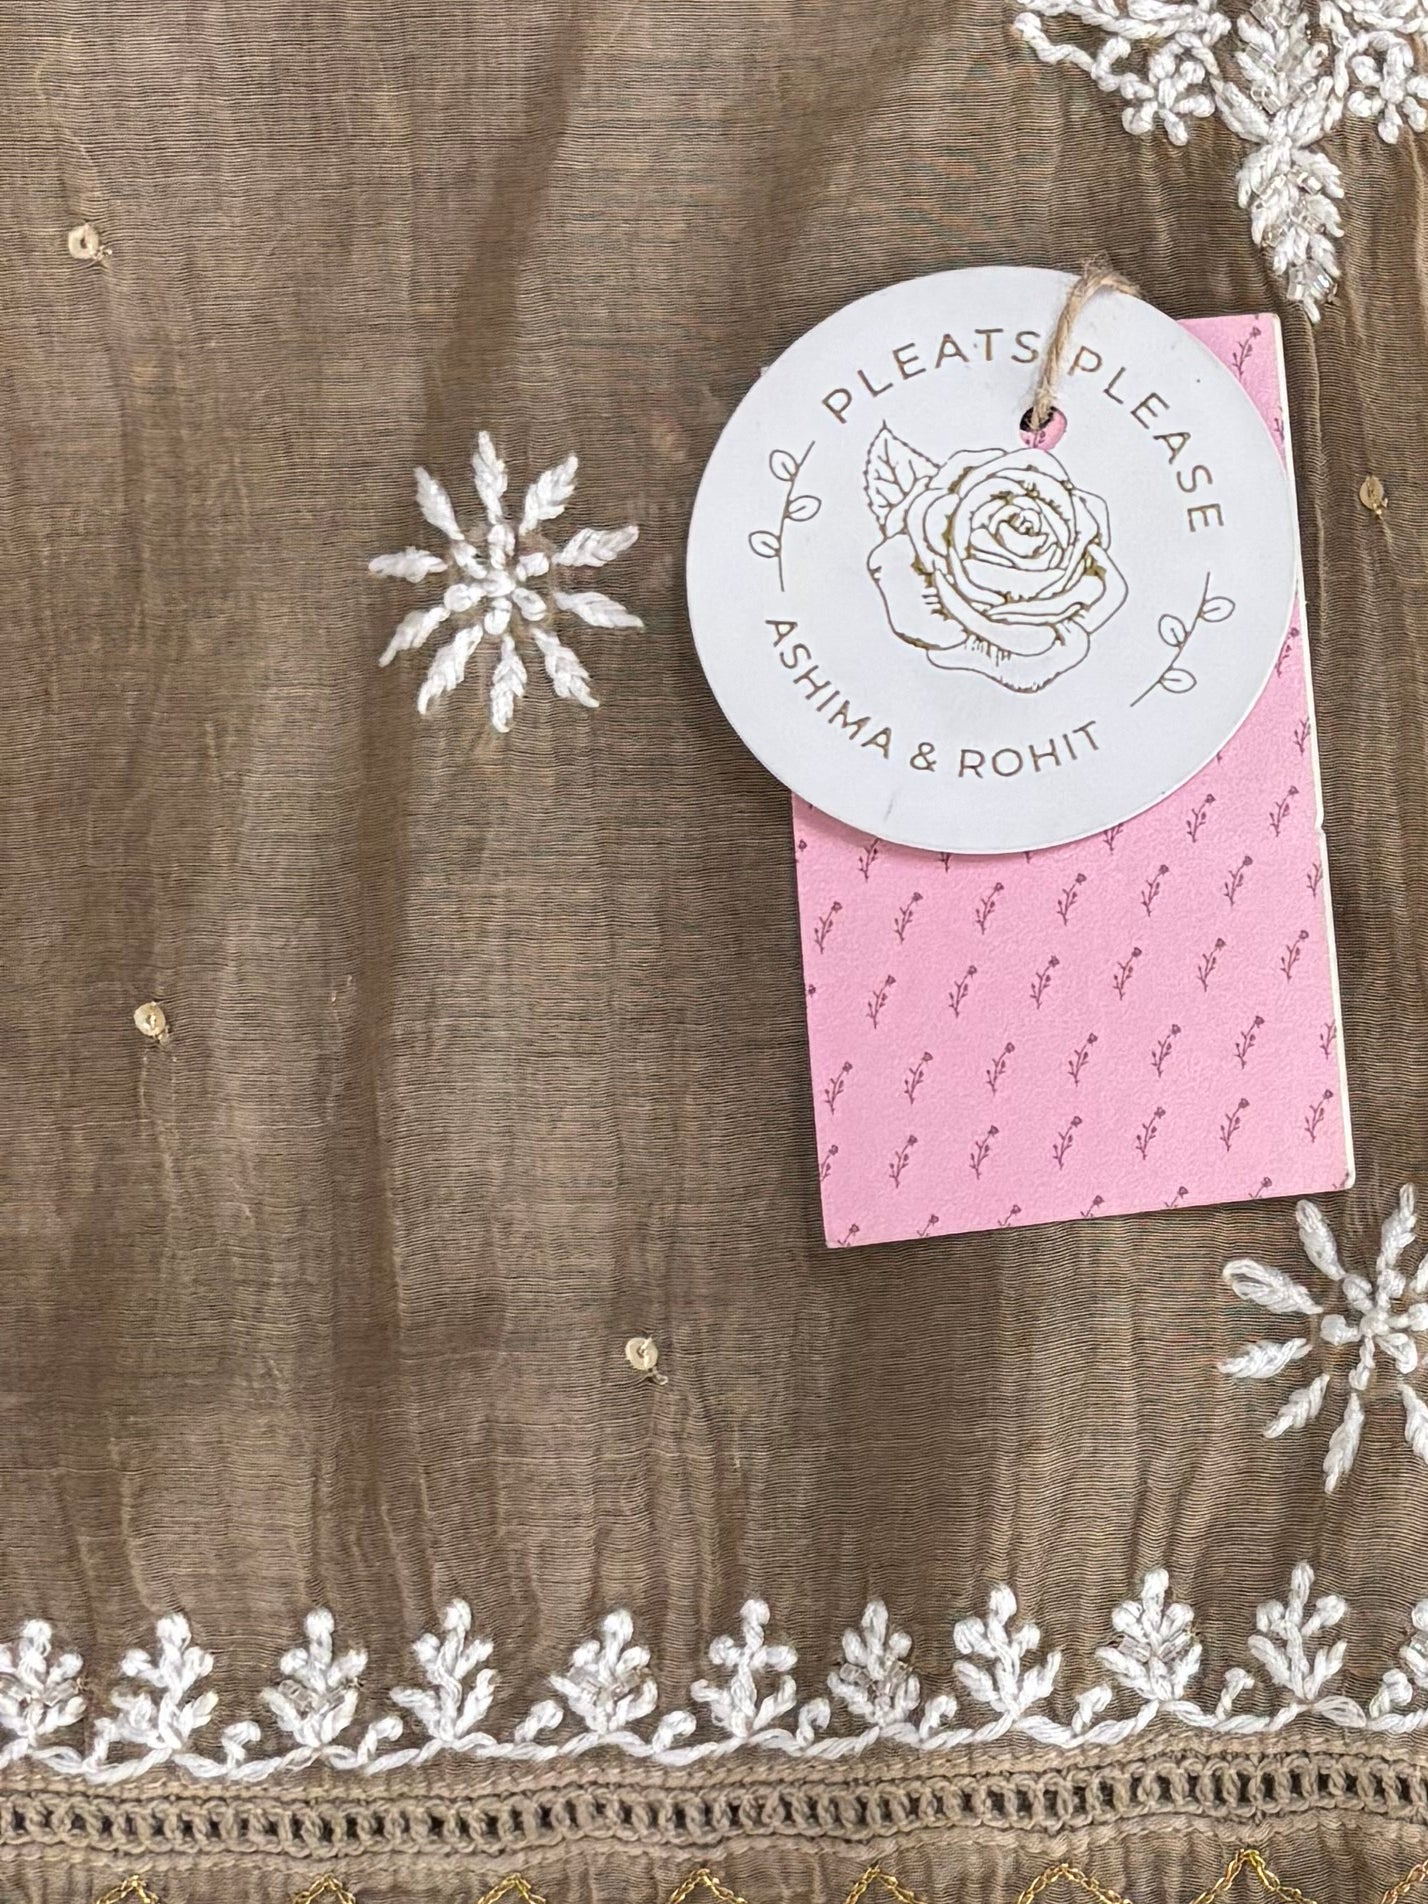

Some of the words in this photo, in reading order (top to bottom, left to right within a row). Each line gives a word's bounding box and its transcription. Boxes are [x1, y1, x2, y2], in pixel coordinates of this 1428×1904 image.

[821, 328, 1038, 423] PLEATS
[1068, 344, 1224, 533] PLEASE
[765, 618, 891, 759] ASHIMA
[909, 741, 937, 773] &
[958, 720, 1100, 779] ROHIT
